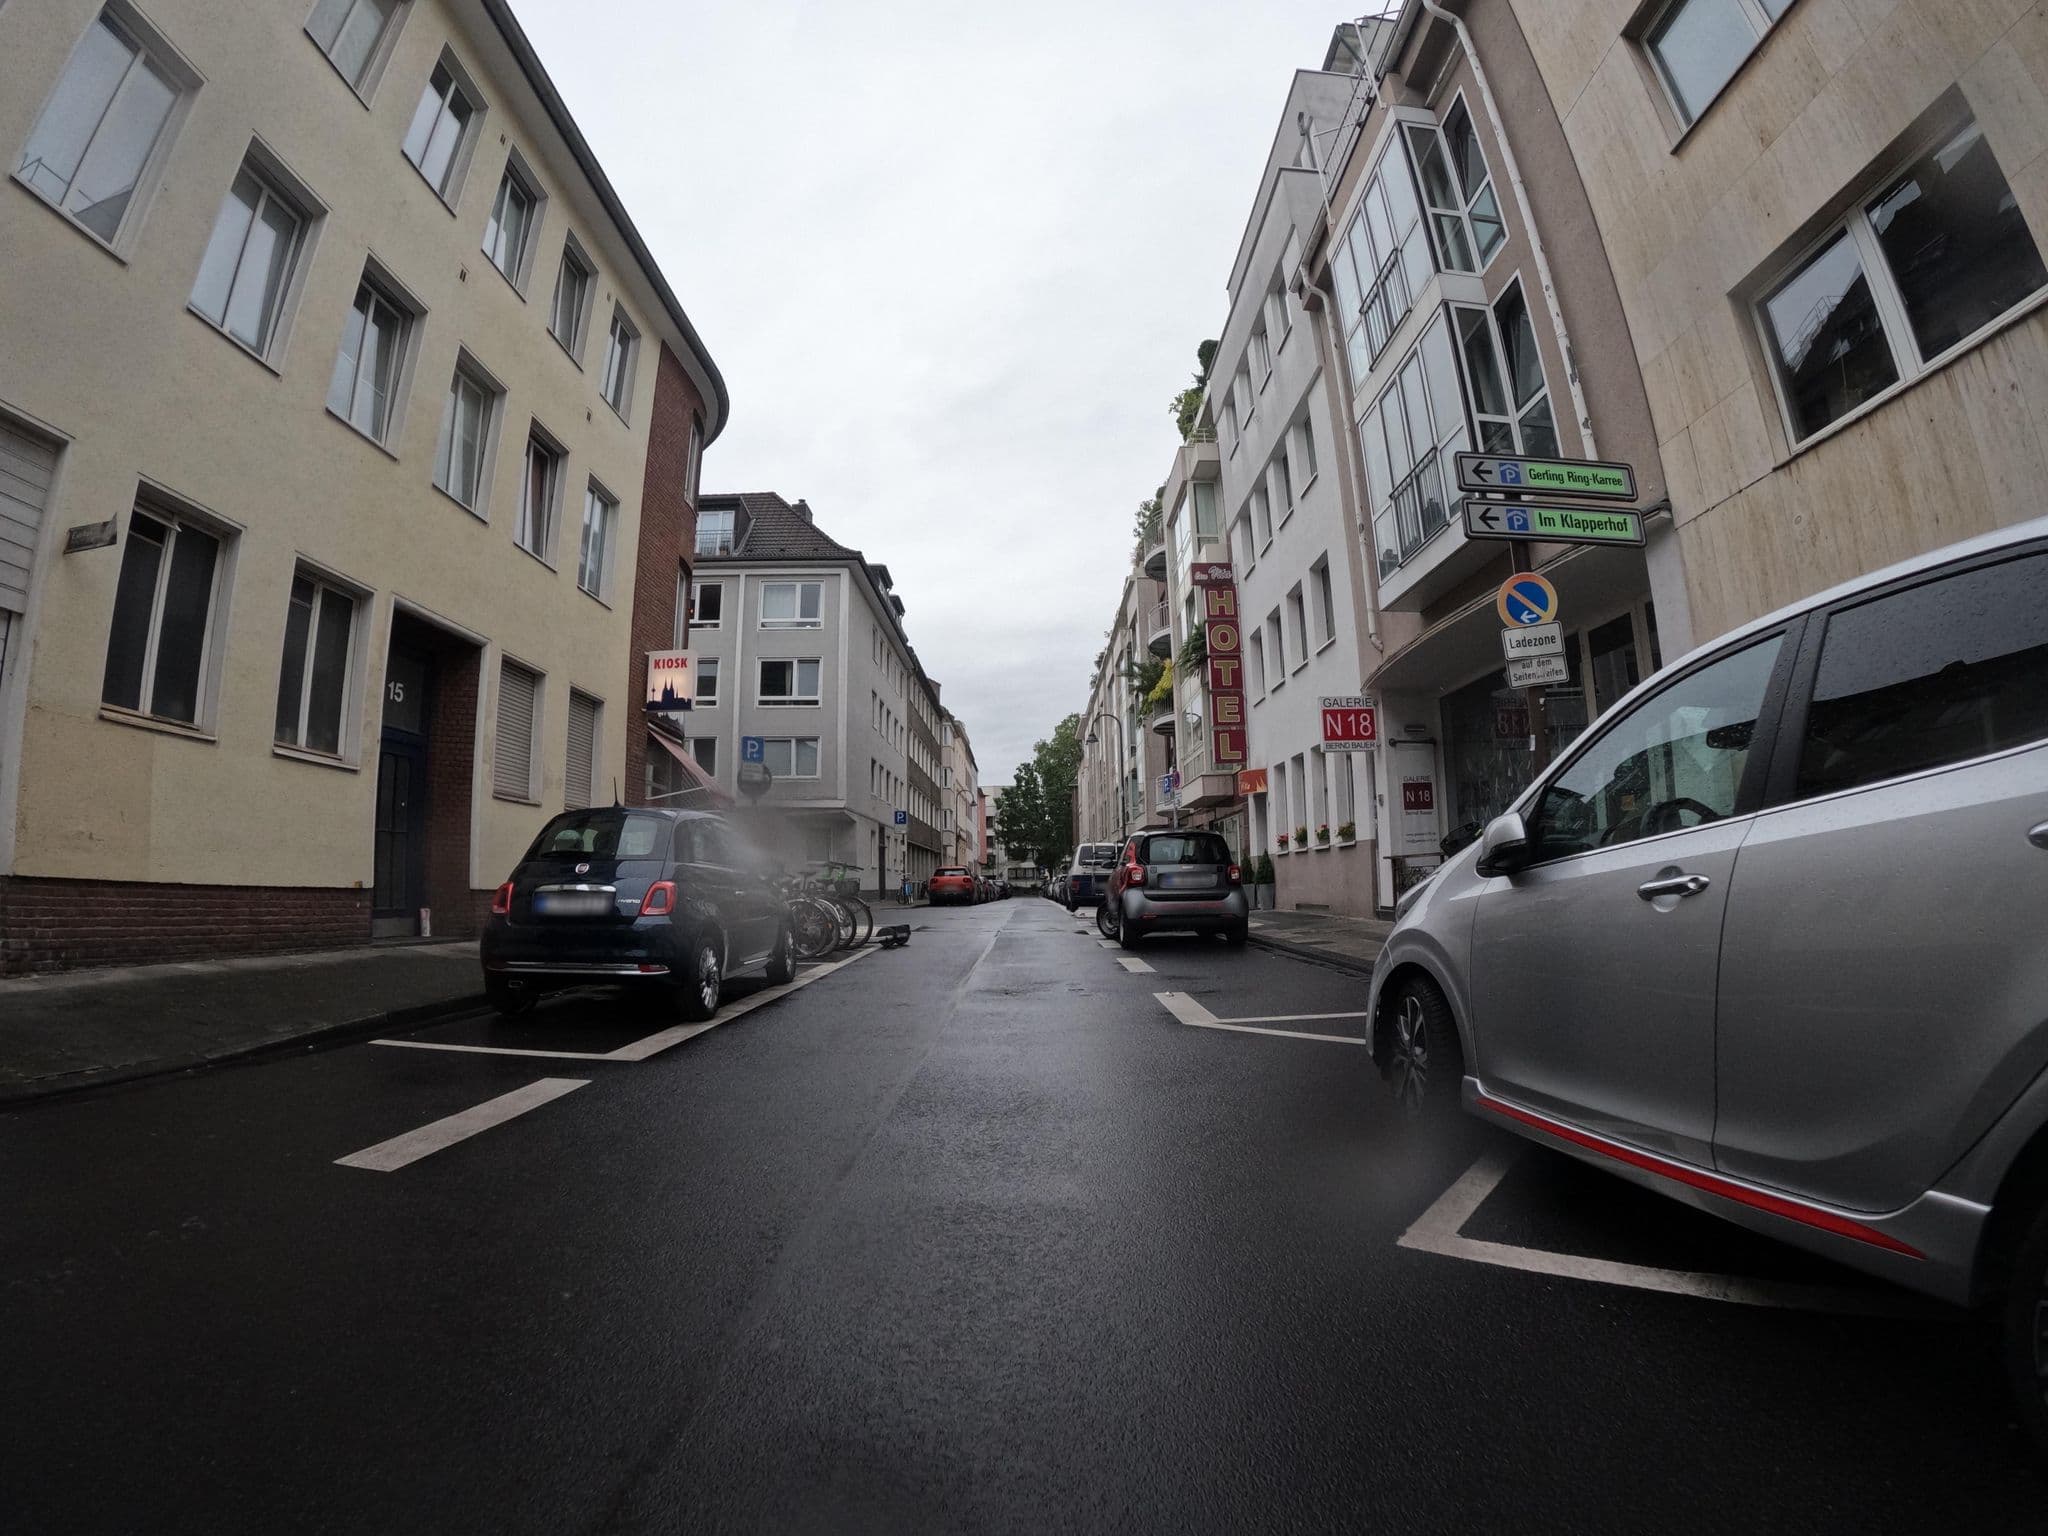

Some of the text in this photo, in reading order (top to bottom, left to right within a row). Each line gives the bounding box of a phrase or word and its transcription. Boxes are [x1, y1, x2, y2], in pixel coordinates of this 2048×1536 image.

[1528, 468, 1565, 485] Gerling
[1567, 471, 1623, 487] Ring-Karree
[1538, 511, 1556, 528] Im
[1560, 513, 1628, 533] Klapperhof
[1509, 635, 1557, 649] Ladezone
[654, 657, 688, 669] KIOSK
[1521, 657, 1552, 669] auf dem
[1208, 590, 1242, 760] HOTEL
[1513, 668, 1565, 682] Seiteneifen
[387, 680, 404, 703] 15
[1322, 697, 1372, 708] GALERIE
[1326, 713, 1372, 737] N 18
[1326, 742, 1350, 750] BERND
[1406, 790, 1431, 802] N 18
